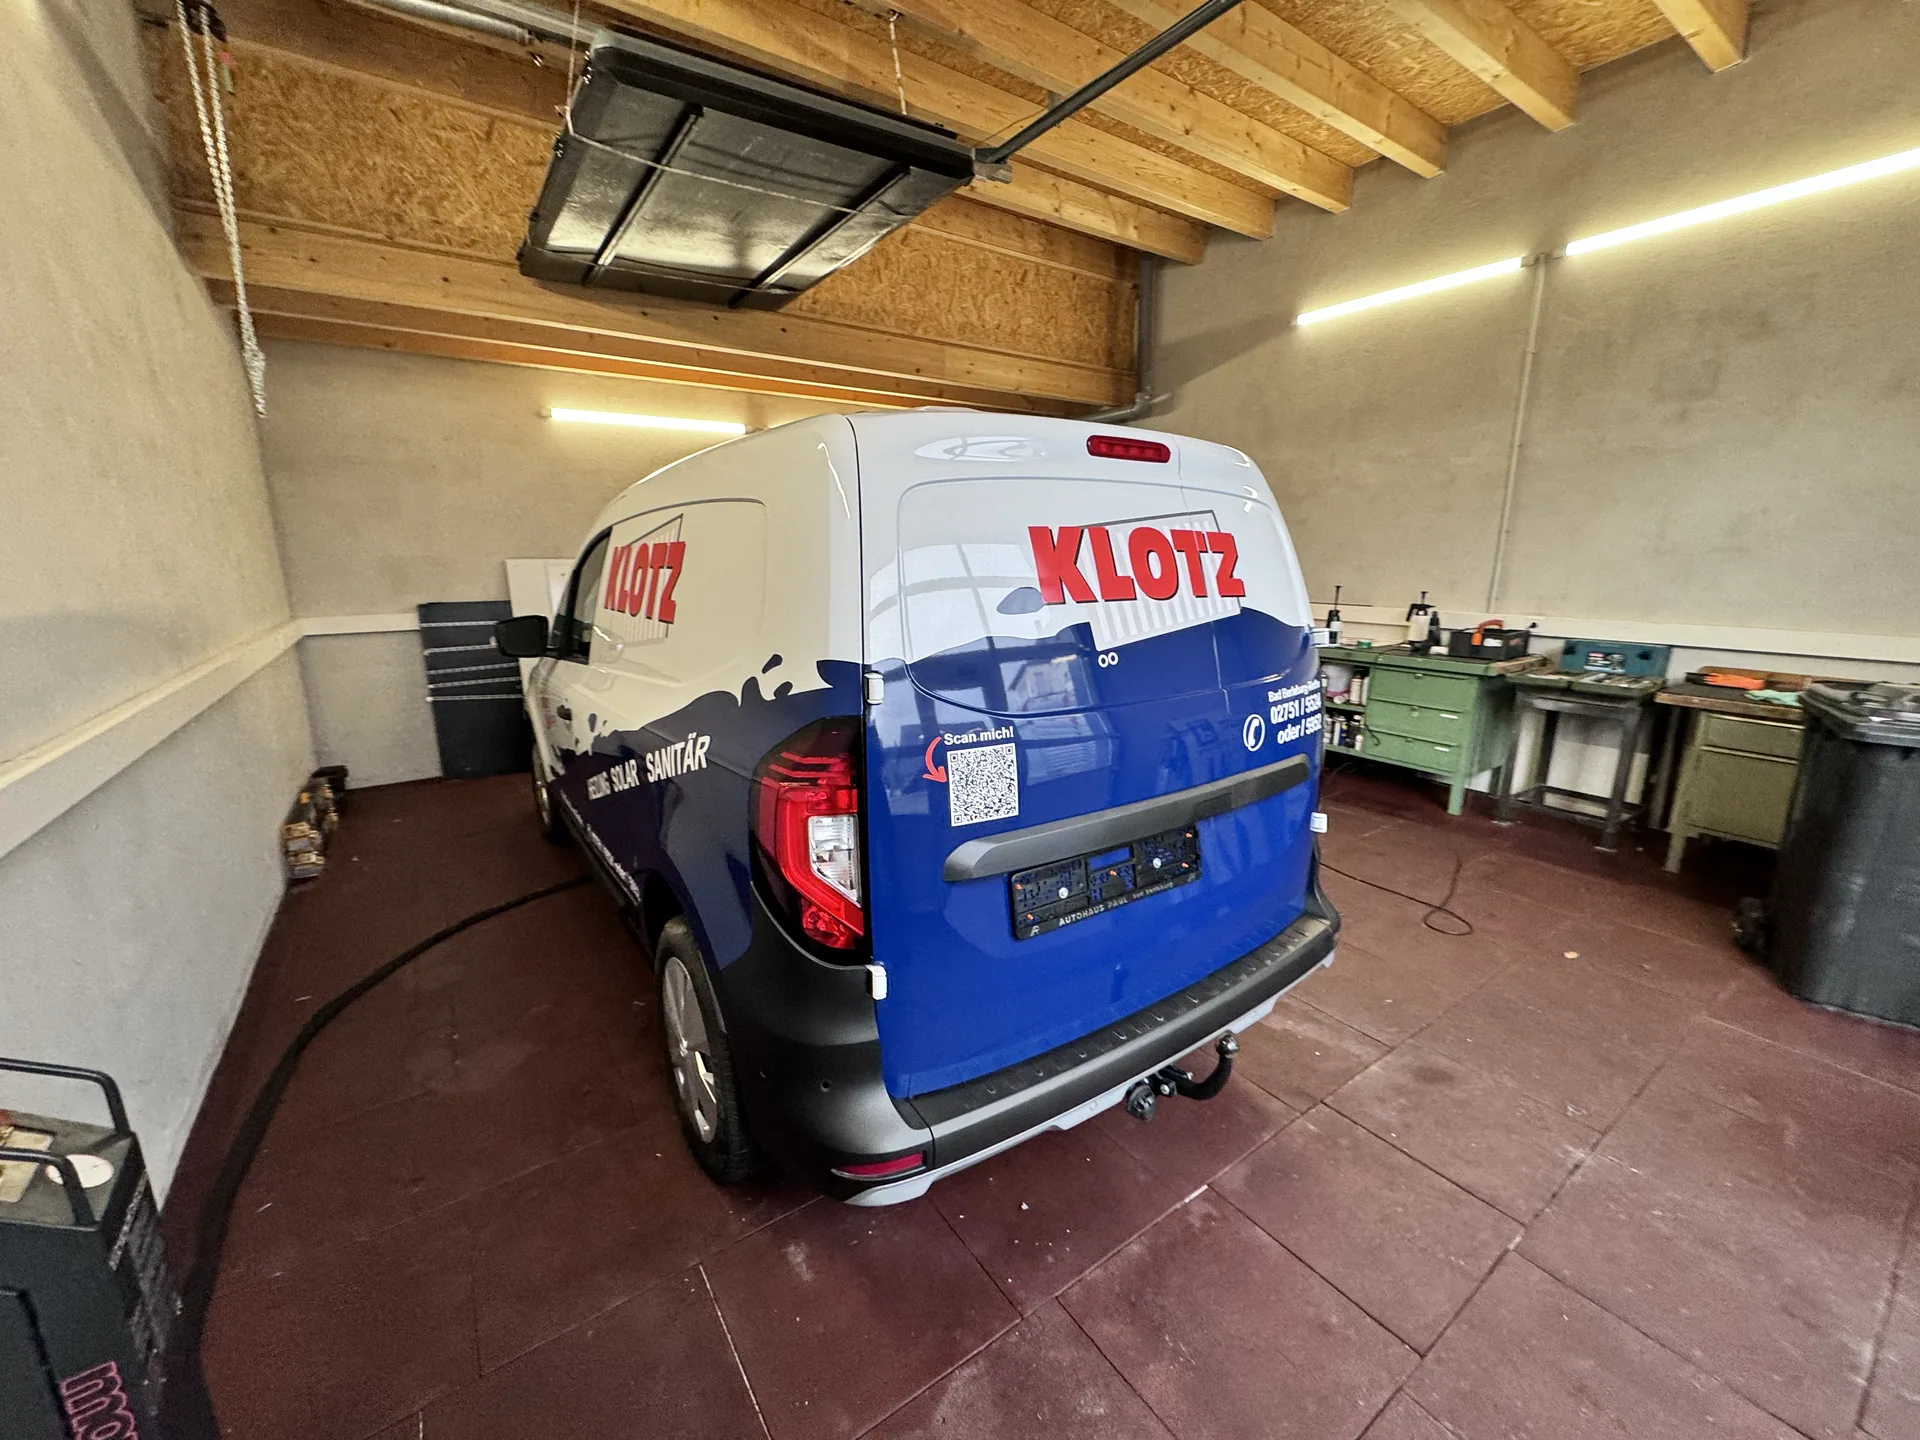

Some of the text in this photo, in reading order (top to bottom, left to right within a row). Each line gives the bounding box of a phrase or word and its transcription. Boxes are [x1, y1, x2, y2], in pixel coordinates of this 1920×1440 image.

[1028, 526, 1246, 605] KLOTZ
[604, 541, 686, 624] KLOTZ
[1270, 700, 1299, 725] 02751
[944, 725, 1014, 745] Scan mich!
[1277, 724, 1300, 744] oder
[610, 759, 640, 792] SOLAR
[645, 732, 711, 783] SANITÄR
[1058, 904, 1105, 926] AUTOHAUS
